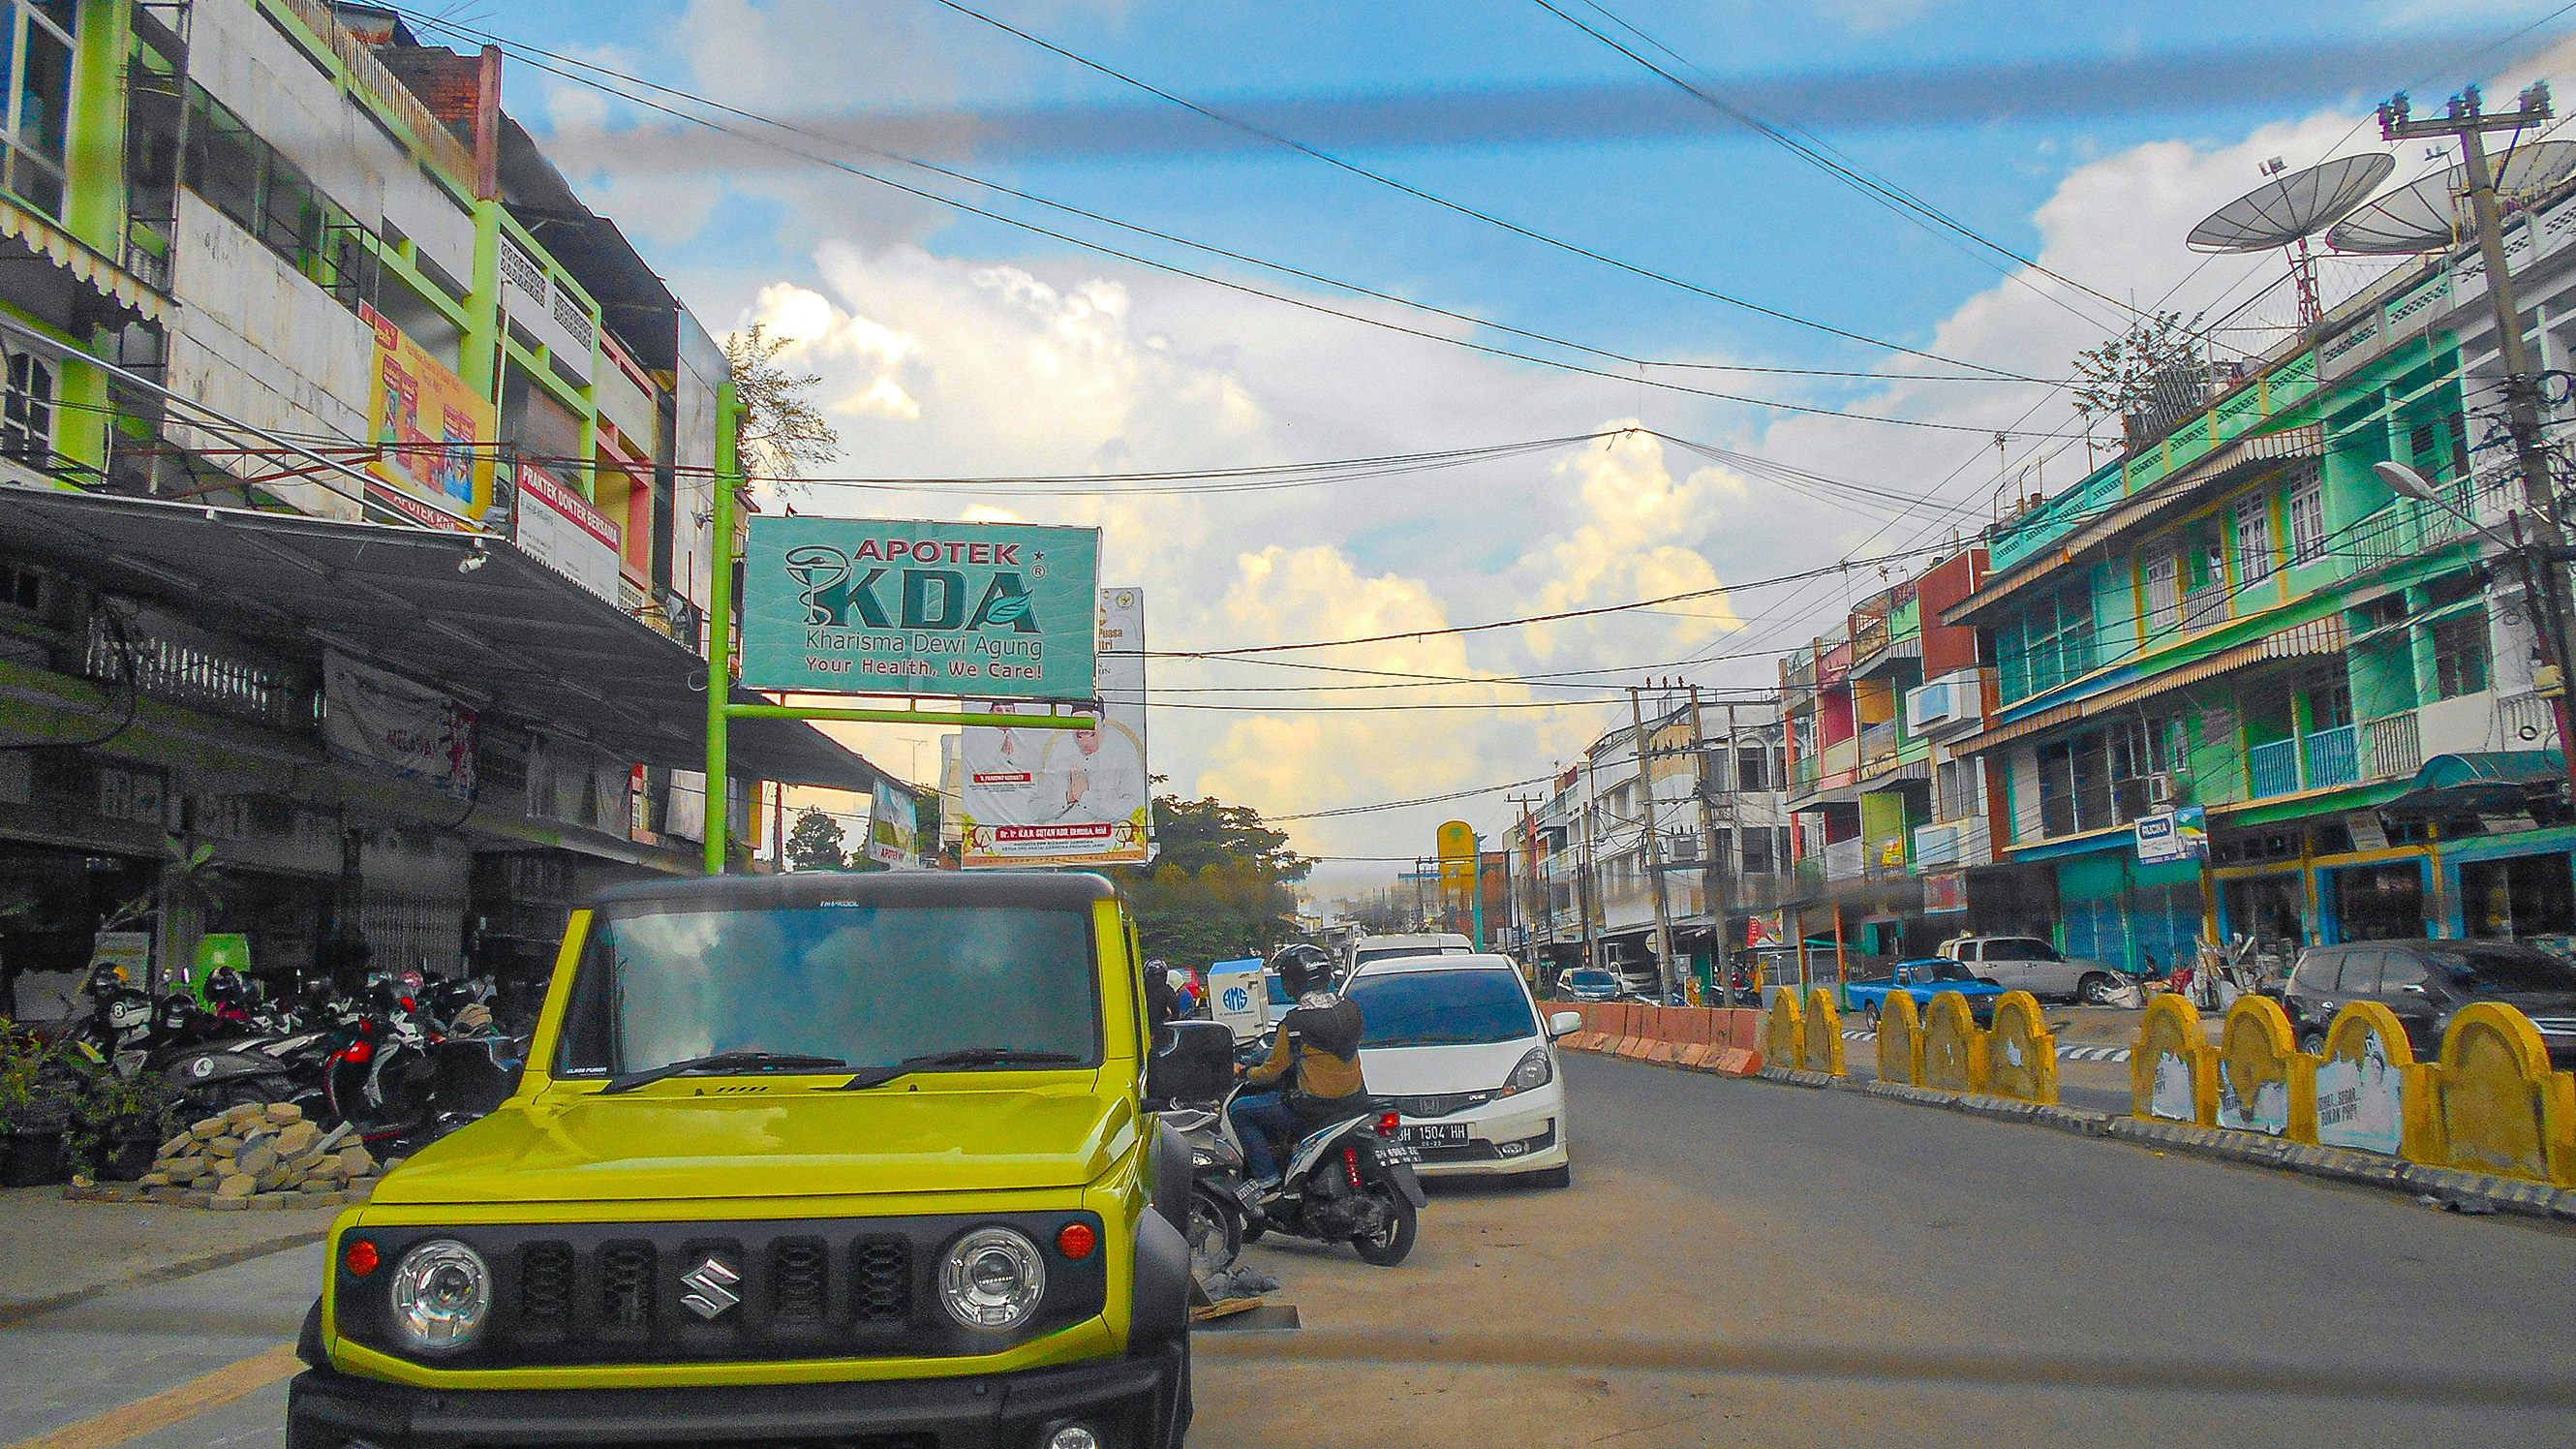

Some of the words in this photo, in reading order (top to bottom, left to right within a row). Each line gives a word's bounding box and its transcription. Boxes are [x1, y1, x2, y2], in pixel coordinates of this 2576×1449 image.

[523, 464, 558, 504] PRAKTEK
[559, 488, 587, 524] DOKTER
[587, 514, 618, 545] BERSAMA
[854, 540, 1021, 567] APOTEK
[812, 567, 1043, 634] KDA
[806, 631, 905, 653] Kharisma
[914, 634, 966, 654] Dewi
[974, 635, 1042, 661] Agung
[806, 657, 852, 673] Your
[862, 659, 937, 677] Health,
[948, 661, 977, 677] We
[988, 663, 1043, 680] Care!
[1223, 986, 1248, 1011] AMS
[1419, 1125, 1445, 1140] 1504
[1451, 1125, 1465, 1139] HH
